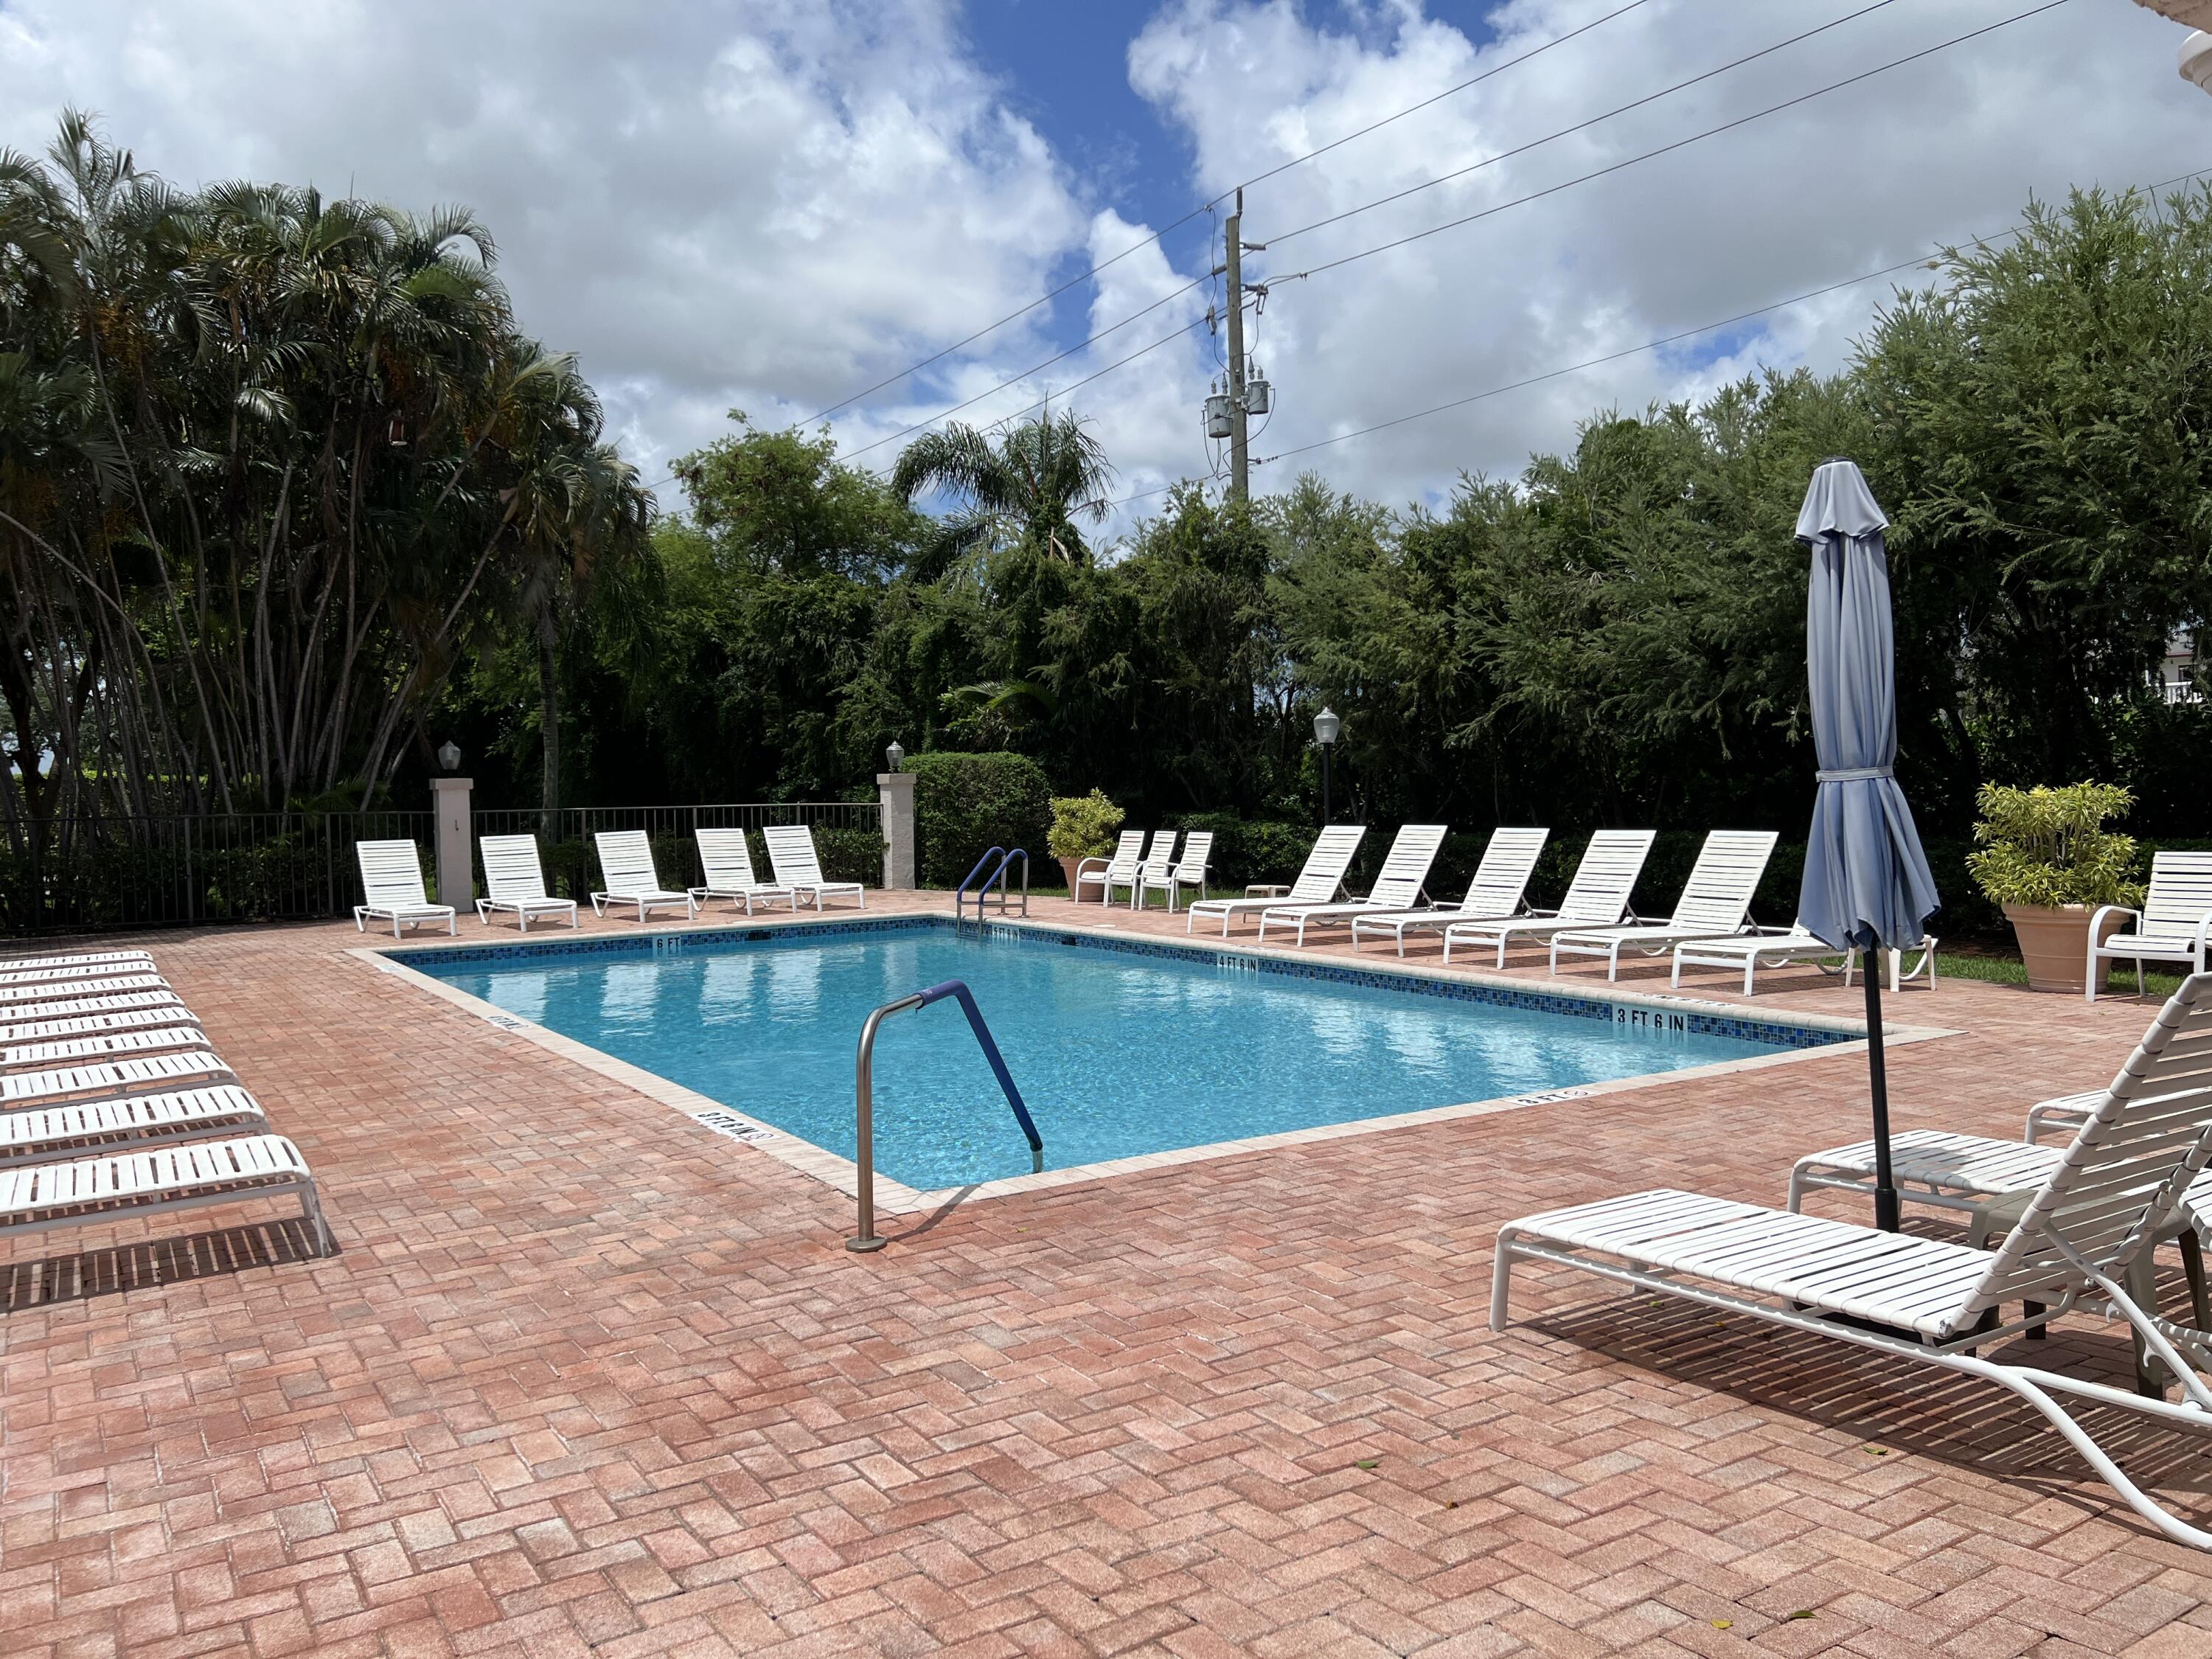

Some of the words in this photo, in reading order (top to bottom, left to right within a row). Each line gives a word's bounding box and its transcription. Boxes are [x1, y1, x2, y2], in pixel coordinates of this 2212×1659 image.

[657, 939, 663, 948] 6
[1220, 956, 1224, 967] 4
[1239, 959, 1245, 970] 6
[1618, 1008, 1625, 1023] 3
[1655, 1014, 1663, 1029] 6
